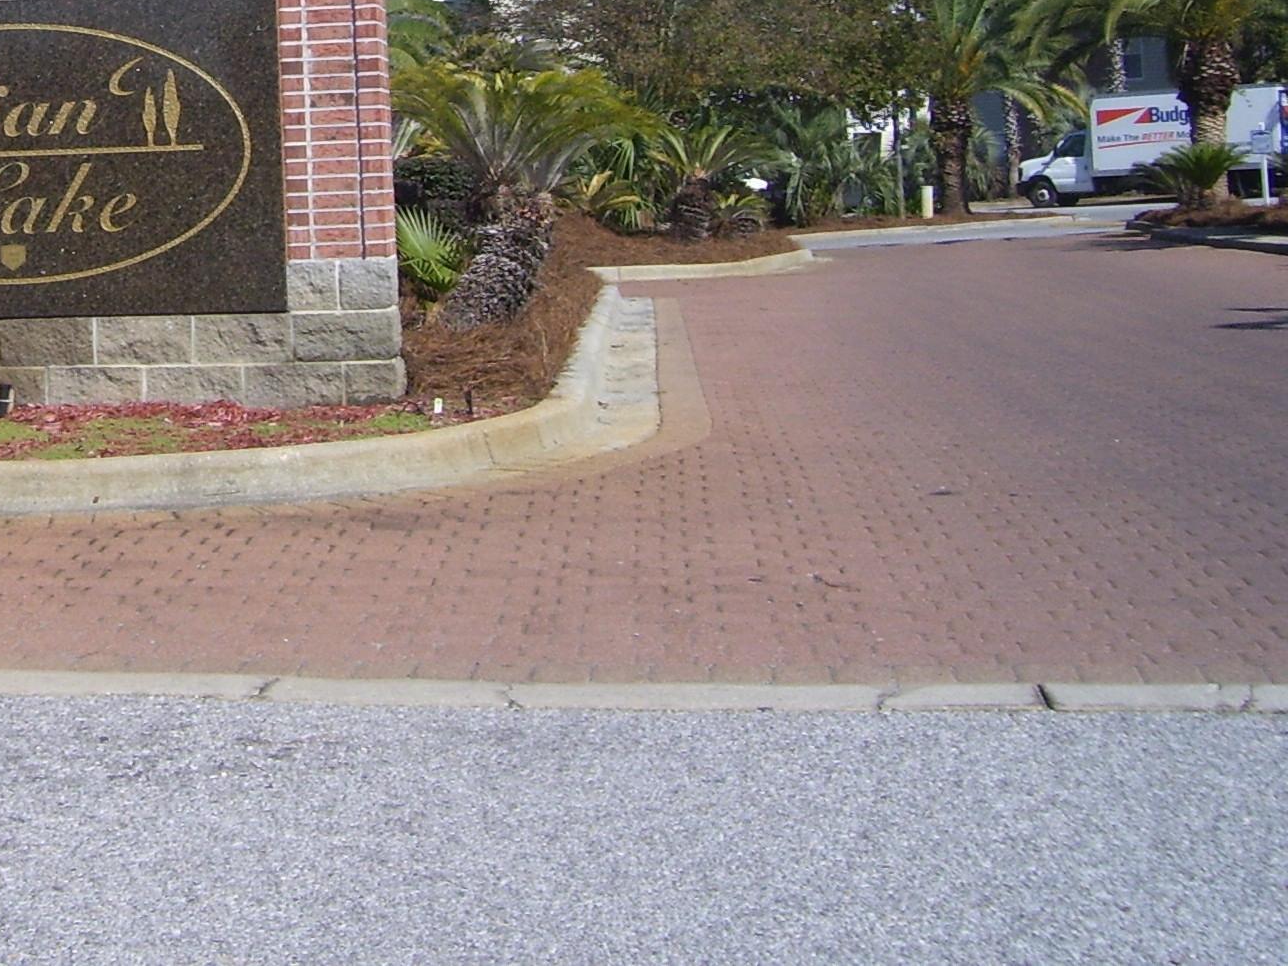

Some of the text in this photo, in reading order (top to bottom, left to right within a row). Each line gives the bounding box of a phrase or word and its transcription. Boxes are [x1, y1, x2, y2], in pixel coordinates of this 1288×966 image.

[1097, 135, 1122, 143] Make
[1124, 134, 1140, 142] The
[1142, 131, 1175, 140] BETTER
